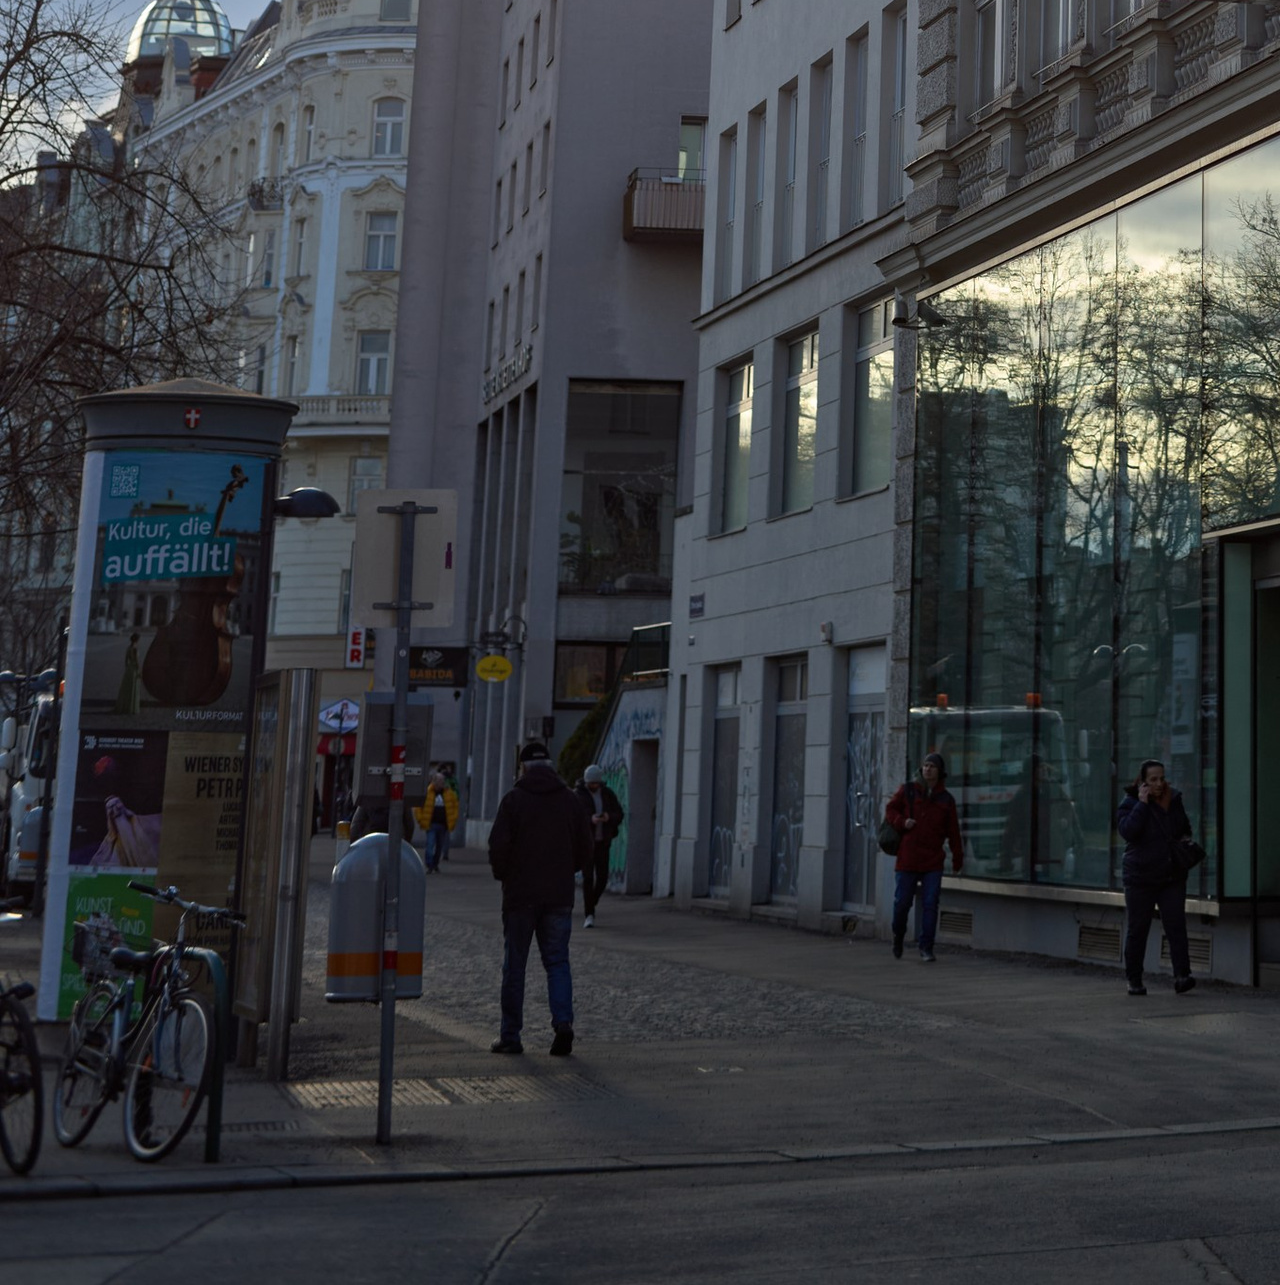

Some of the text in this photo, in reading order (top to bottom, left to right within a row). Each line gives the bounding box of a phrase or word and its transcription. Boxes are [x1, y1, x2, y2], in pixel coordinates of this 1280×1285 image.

[108, 517, 212, 541] Kultur, die
[104, 542, 231, 579] auffällt!
[184, 756, 230, 773] WIENER
[196, 778, 233, 799] PETR
[75, 896, 114, 913] KUNST
